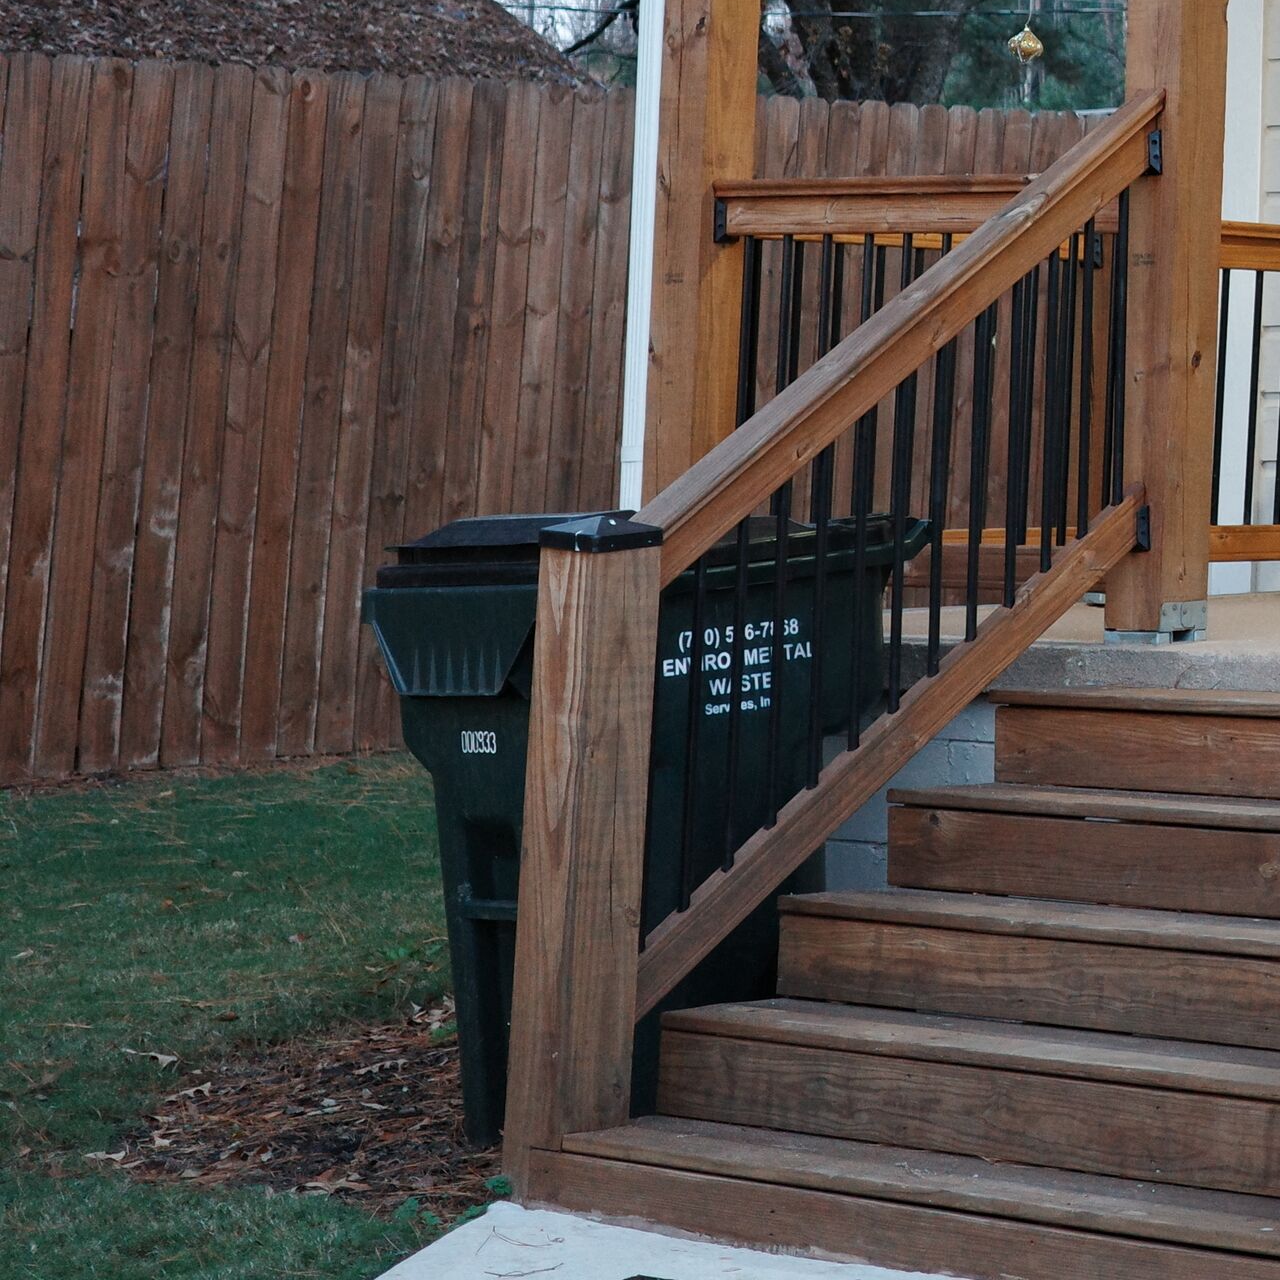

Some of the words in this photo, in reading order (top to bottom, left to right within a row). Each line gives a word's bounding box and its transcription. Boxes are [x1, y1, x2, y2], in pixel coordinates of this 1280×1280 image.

[678, 627, 720, 653] (70)
[725, 618, 799, 643] 56-768
[663, 641, 812, 677] ENIROMETAL
[705, 699, 758, 716] Serves,
[760, 696, 771, 708] In
